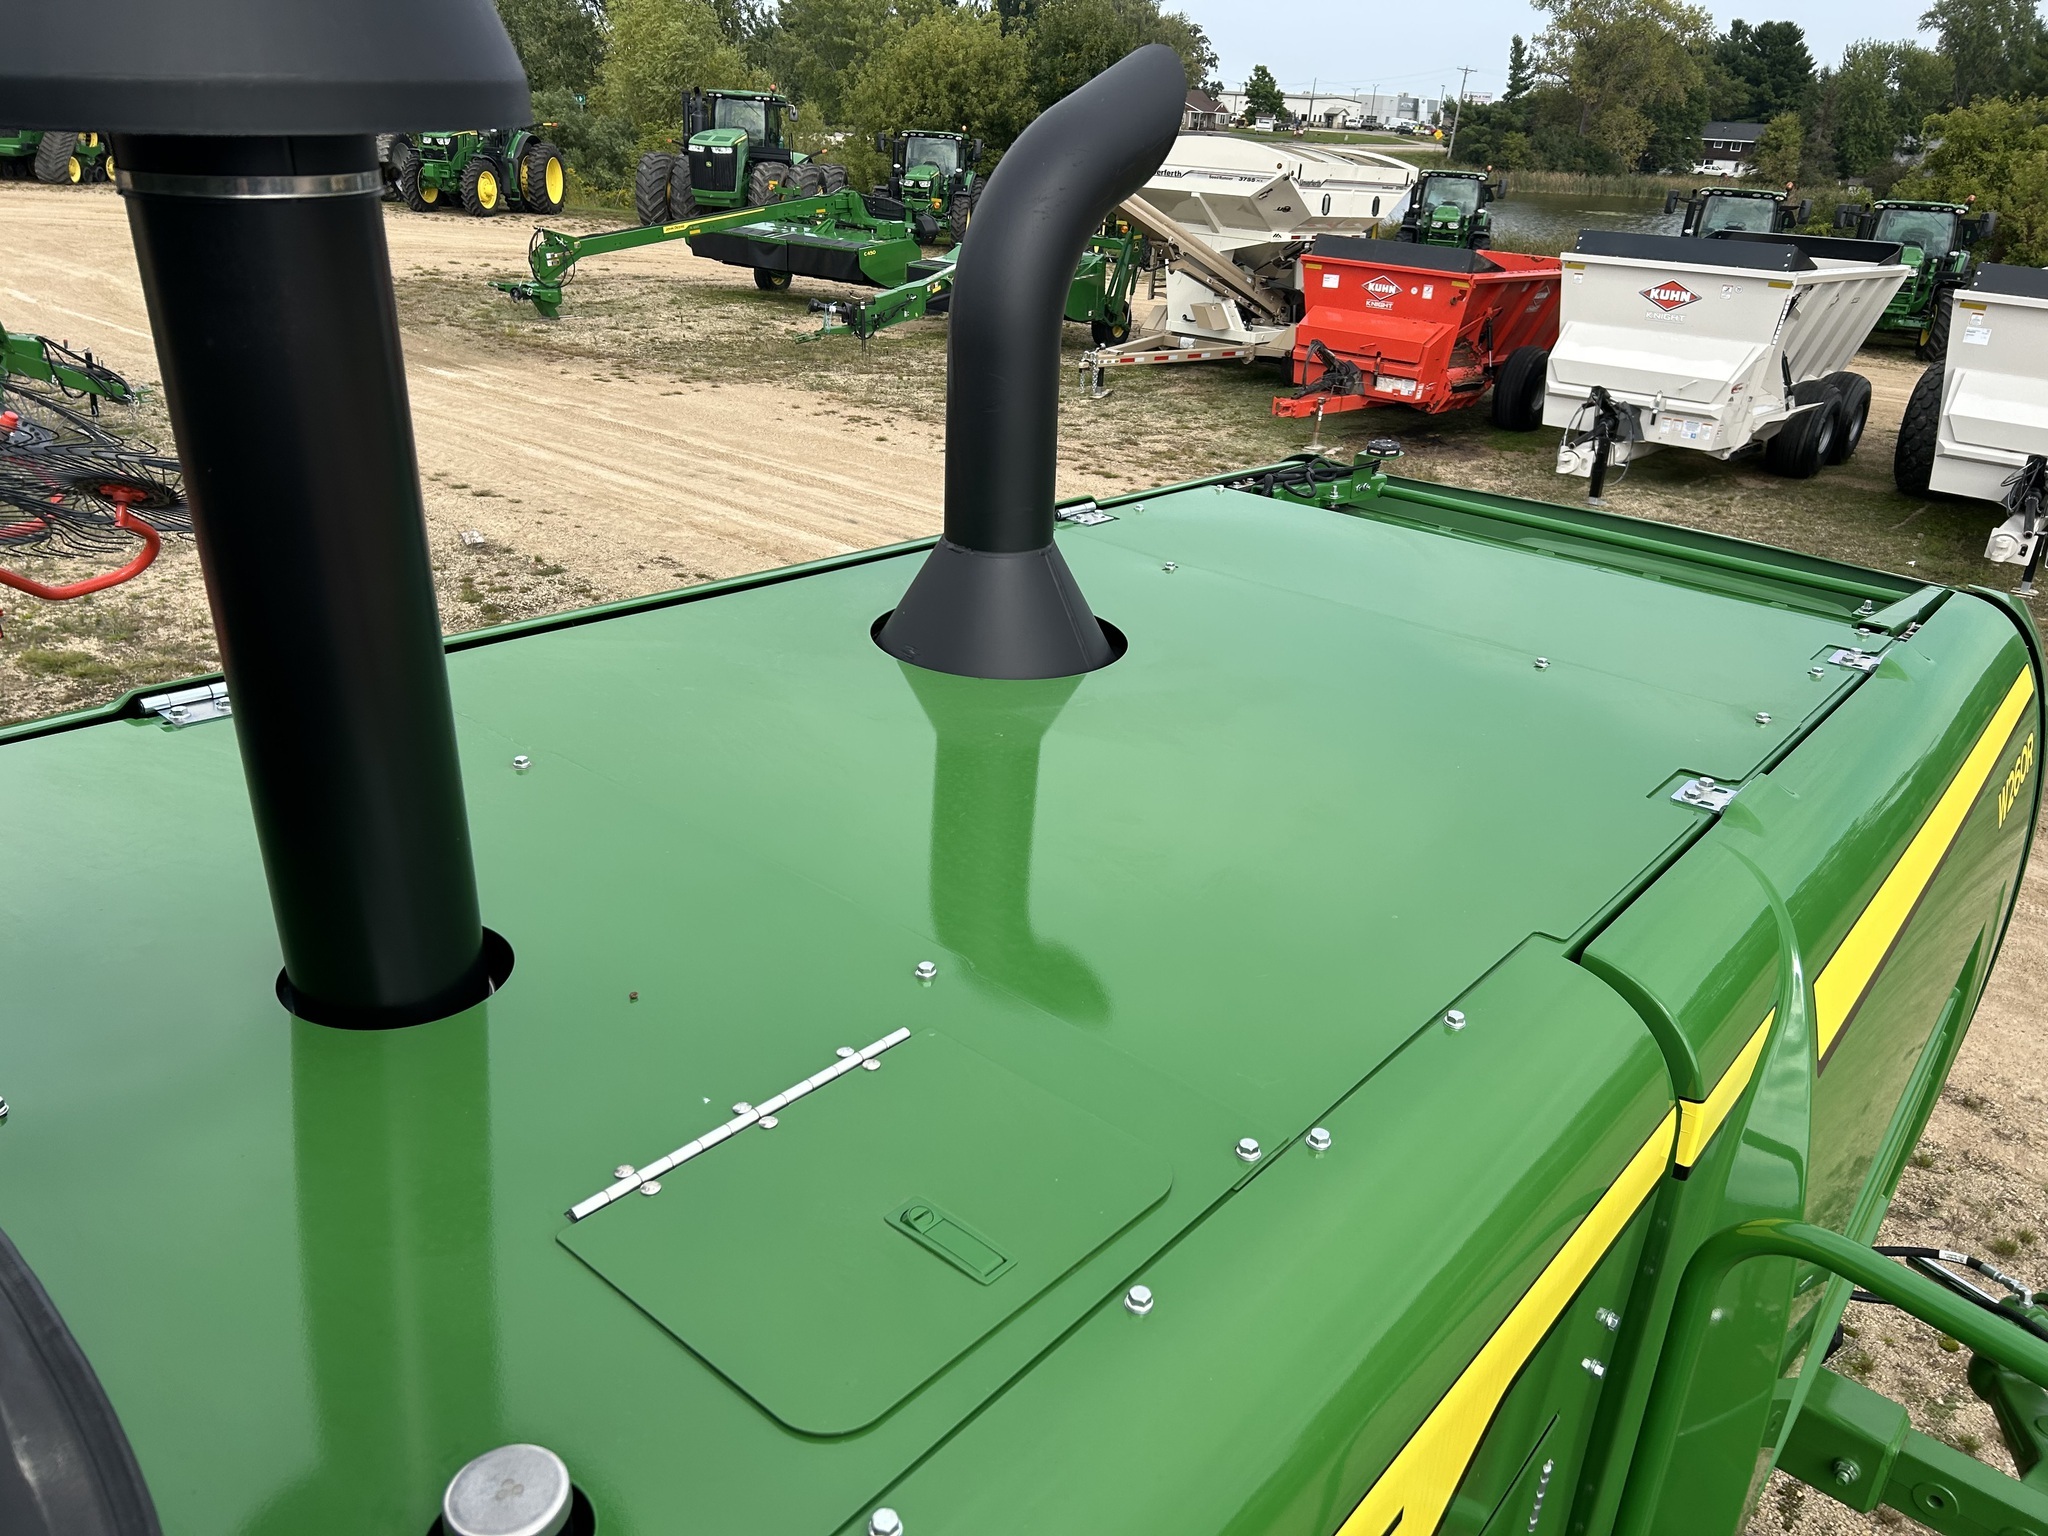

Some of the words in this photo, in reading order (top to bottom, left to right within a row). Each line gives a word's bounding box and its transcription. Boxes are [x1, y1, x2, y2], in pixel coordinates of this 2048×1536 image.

[1368, 282, 1397, 294] KUHN
[1649, 288, 1691, 303] KUHN
[1366, 300, 1394, 309] KNIGHT
[1645, 311, 1686, 322] KNIGHT
[1998, 732, 2034, 830] W260R
